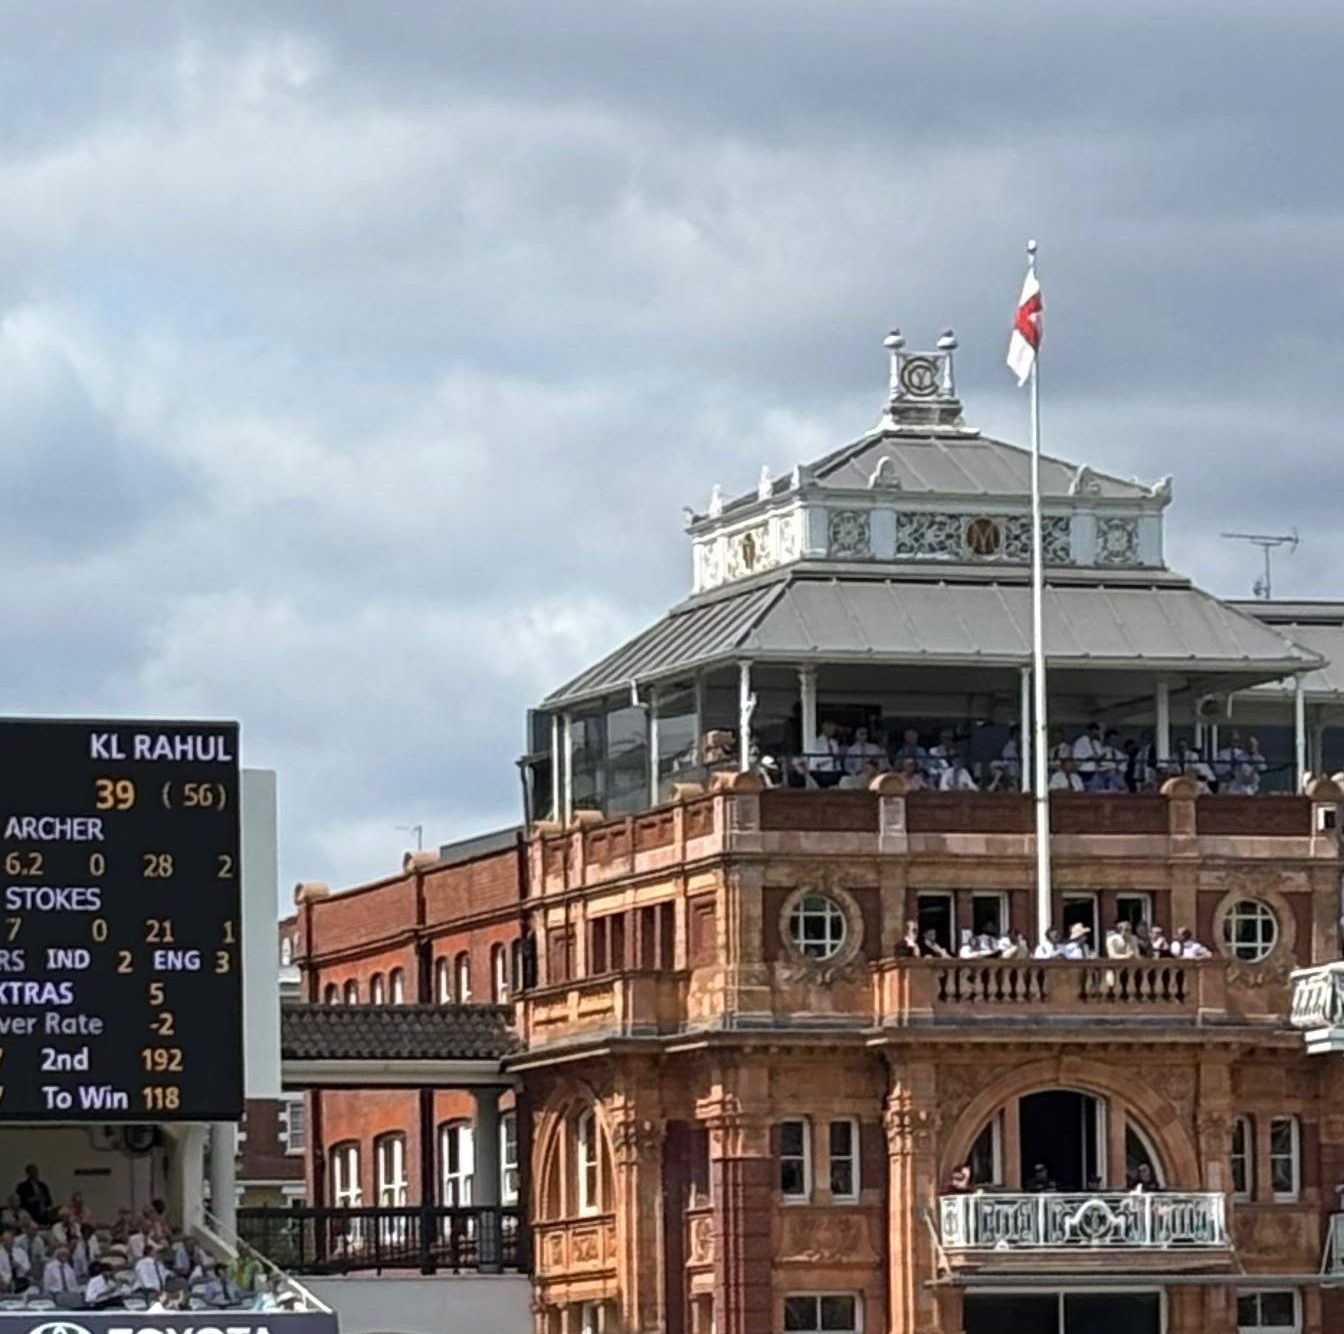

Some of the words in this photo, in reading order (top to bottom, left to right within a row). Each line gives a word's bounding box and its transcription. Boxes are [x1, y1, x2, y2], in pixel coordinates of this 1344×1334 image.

[91, 734, 125, 759] KL
[135, 735, 232, 761] RAHUL
[96, 780, 134, 809] 39
[5, 817, 104, 840] ARCHER
[6, 852, 43, 875] 6.2
[90, 854, 104, 875] 0
[144, 854, 172, 877] 28
[218, 855, 232, 877] 2
[6, 887, 100, 910] STOKES
[7, 918, 21, 940] 7
[93, 919, 107, 941] 0
[146, 920, 173, 942] 21
[224, 921, 235, 943] 1
[48, 949, 90, 968] IND
[118, 951, 132, 973] 2
[155, 950, 200, 970] ENG
[216, 952, 229, 973] 3
[150, 983, 163, 1005] 5
[45, 1012, 103, 1034] Rate
[42, 1047, 88, 1070] 2nd
[143, 1049, 182, 1071] 192
[43, 1087, 73, 1109] To
[80, 1086, 127, 1109] Win
[144, 1087, 179, 1109] 118
